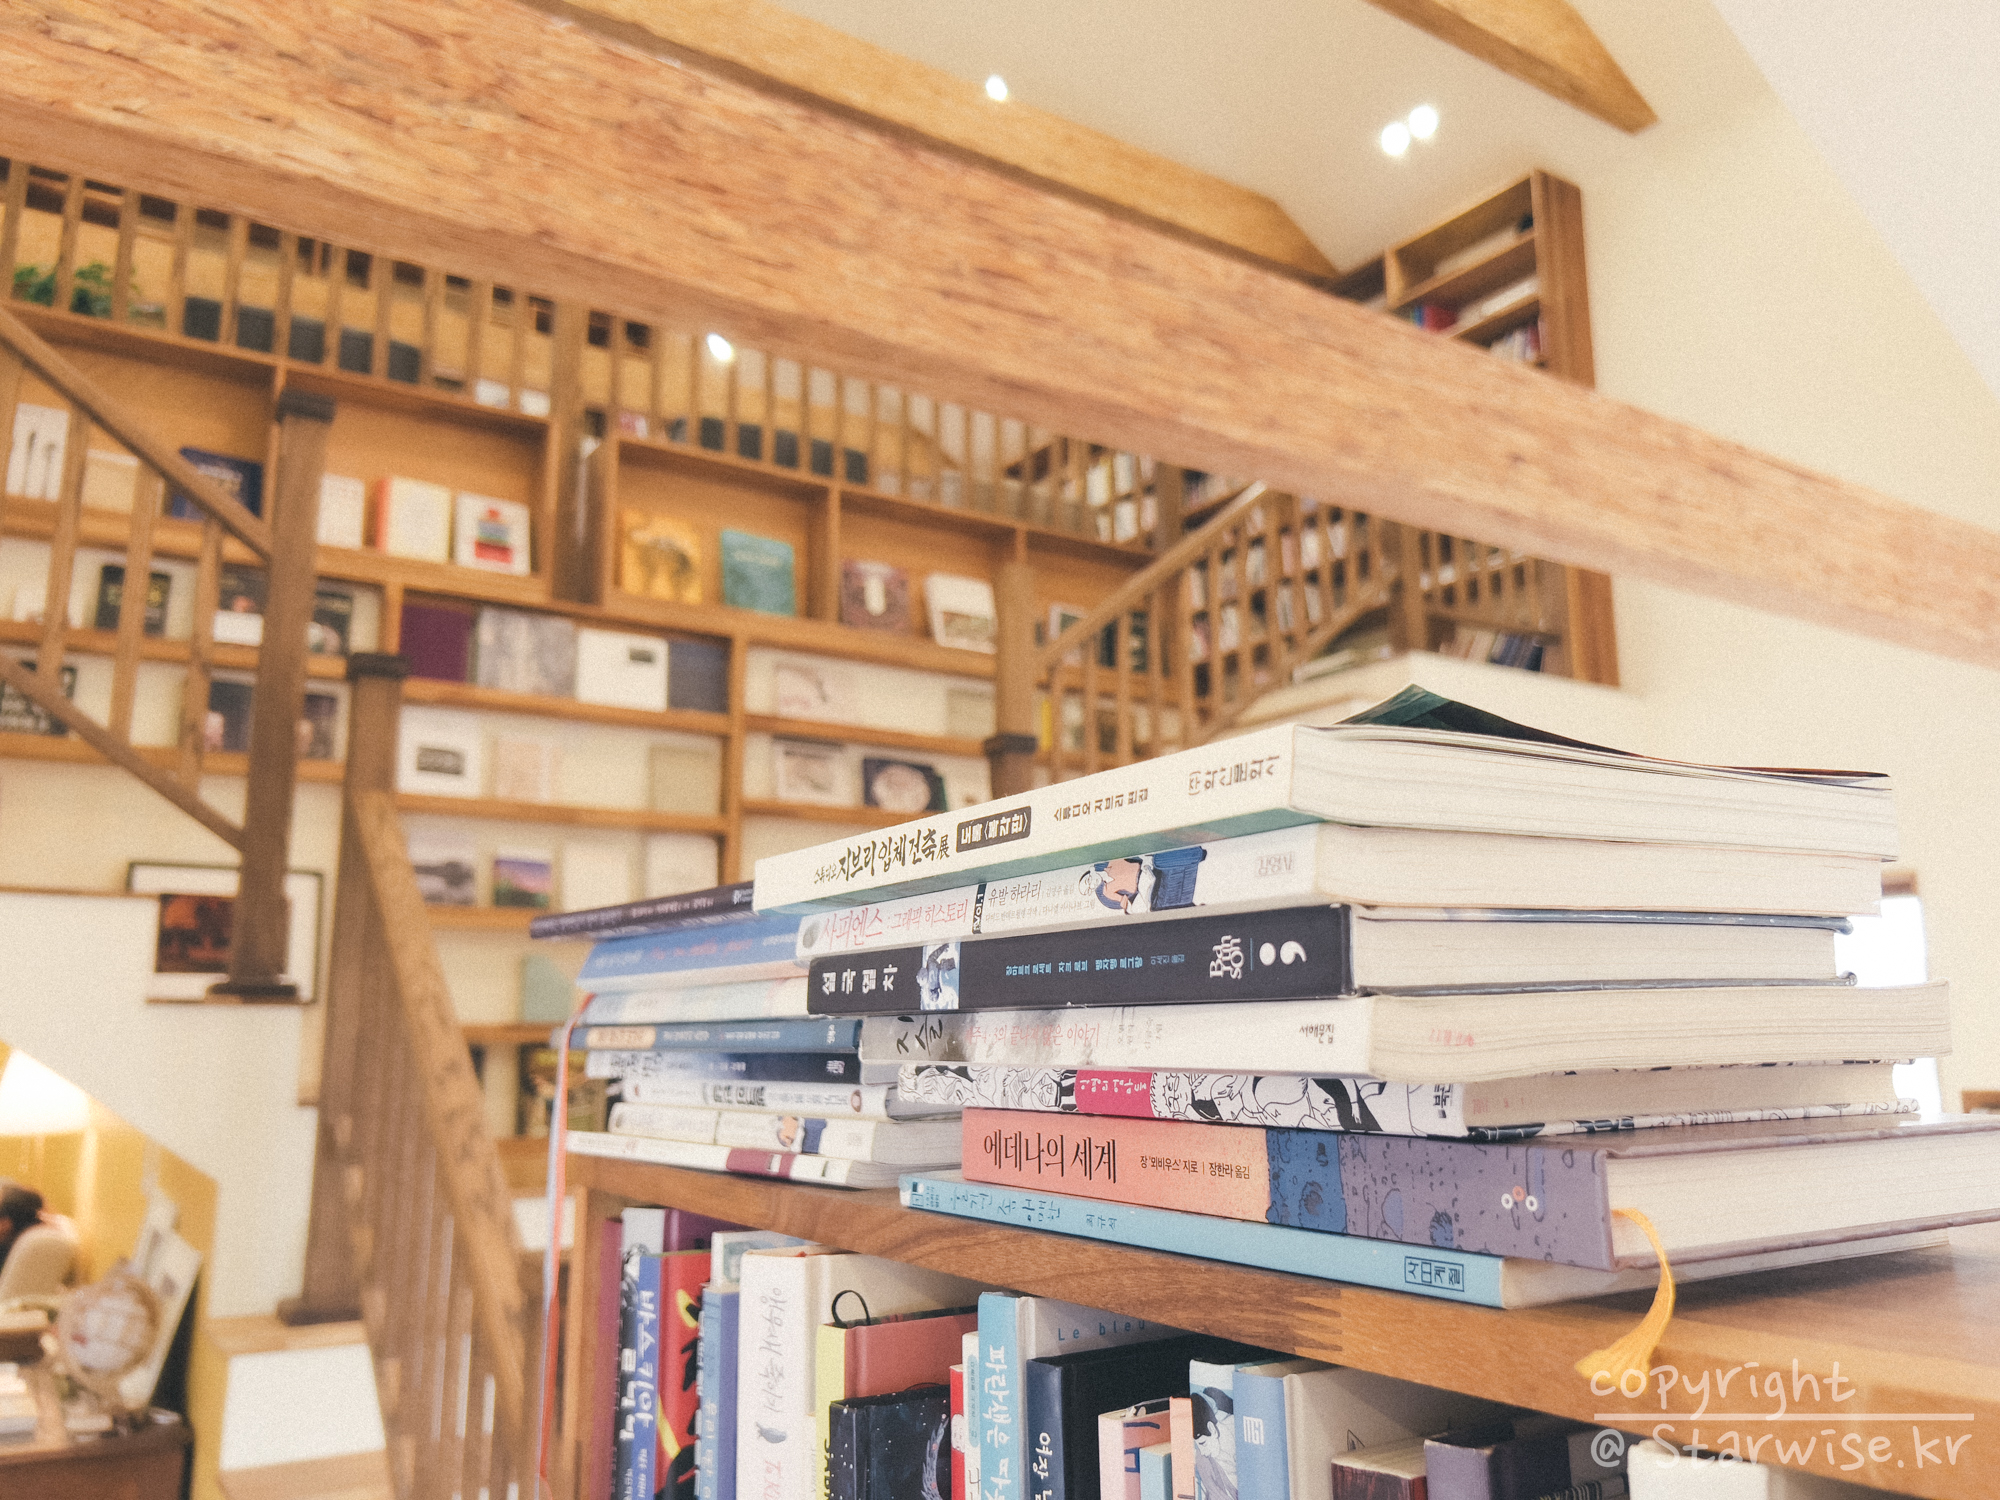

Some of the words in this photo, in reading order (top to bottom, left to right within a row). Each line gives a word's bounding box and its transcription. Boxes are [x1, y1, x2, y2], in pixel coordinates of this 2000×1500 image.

[1053, 800, 1091, 822] 스튜디오
[1094, 793, 1124, 813] 지브리
[1128, 787, 1149, 804] 편집
[1257, 852, 1294, 875] 김영사
[988, 886, 1009, 908] 유발
[1010, 880, 1042, 904] 하라리
[820, 907, 884, 950] 사피엔스
[925, 898, 969, 928] 히스토리
[1058, 961, 1072, 973] 자크
[1095, 958, 1118, 971] 뱅자맹
[1119, 956, 1143, 970] 르그랑
[821, 964, 898, 996] 설국열차
[1010, 1024, 1039, 1046] 끝나지
[1042, 1024, 1063, 1047] 않은
[1067, 1023, 1100, 1047] 이야기
[1112, 1077, 1147, 1095] 엄마들
[983, 1128, 1065, 1178] 에데나의
[1070, 1136, 1117, 1184] 세계
[1140, 1155, 1148, 1169] 장
[1183, 1160, 1198, 1174] 지로
[1209, 1161, 1233, 1178] 장한라
[1235, 1165, 1250, 1180] 옮김
[1086, 1213, 1118, 1230] 최규석
[760, 1286, 788, 1357] 앵무새
[1057, 1327, 1080, 1341] Le
[1098, 1320, 1145, 1336] bleu
[759, 1358, 785, 1414] 죽이기
[982, 1344, 1012, 1449] 파란색은
[1032, 1432, 1053, 1481] 여장
